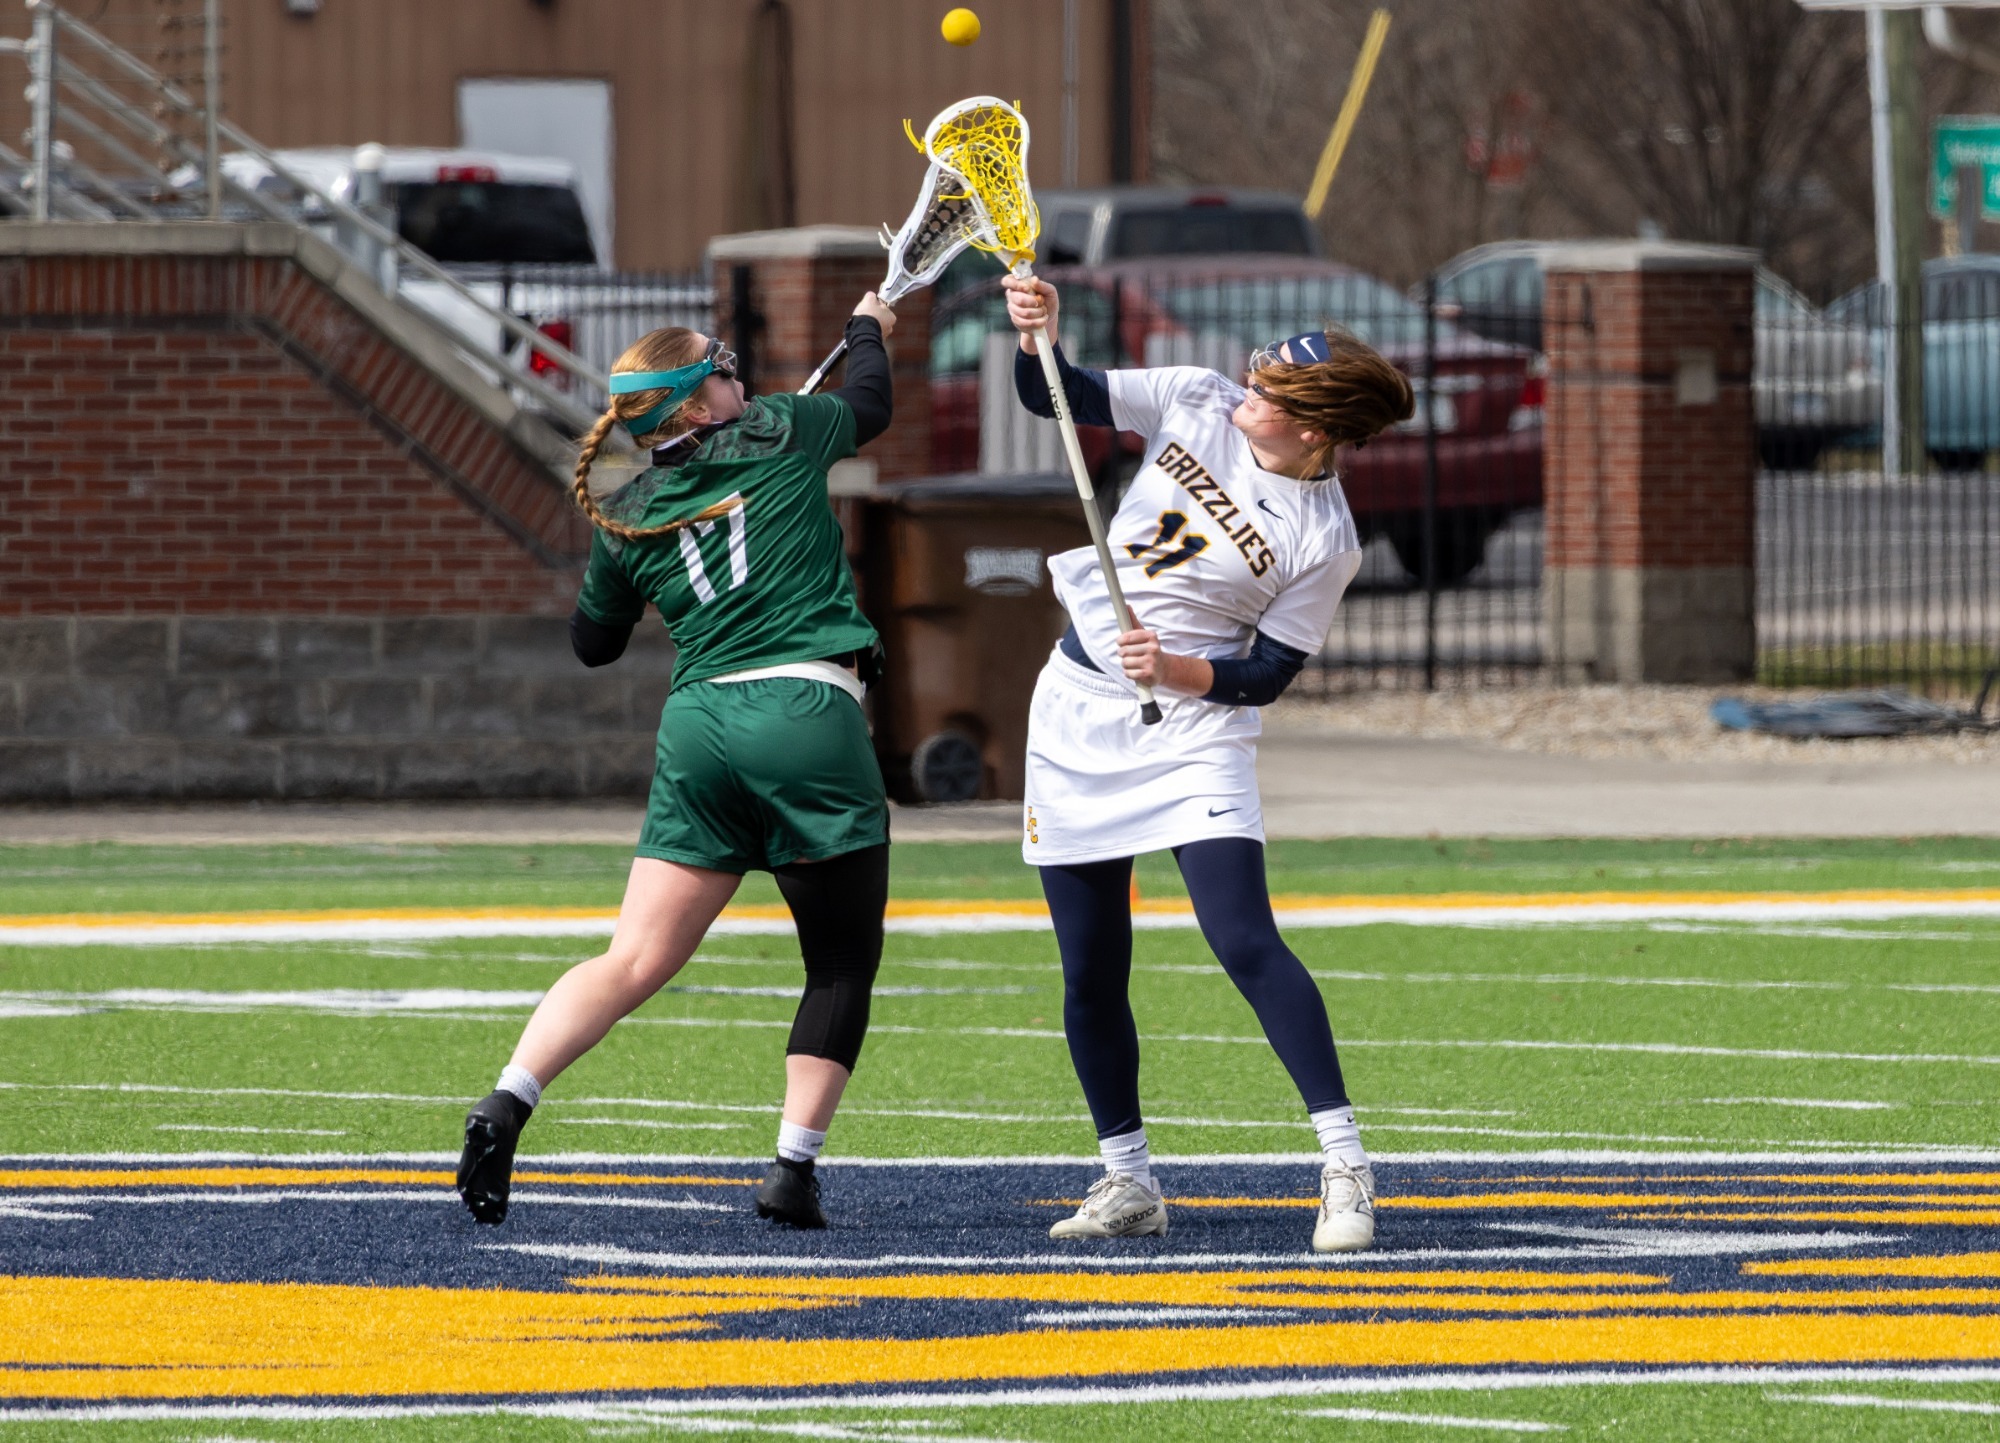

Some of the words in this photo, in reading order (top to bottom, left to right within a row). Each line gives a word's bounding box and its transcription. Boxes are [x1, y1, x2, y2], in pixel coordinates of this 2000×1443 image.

[678, 490, 748, 606] 17
[1124, 510, 1211, 580] 11
[1155, 441, 1276, 578] GRIZZLIES
[1103, 1218, 1122, 1229] new
[1122, 1204, 1158, 1226] balance
